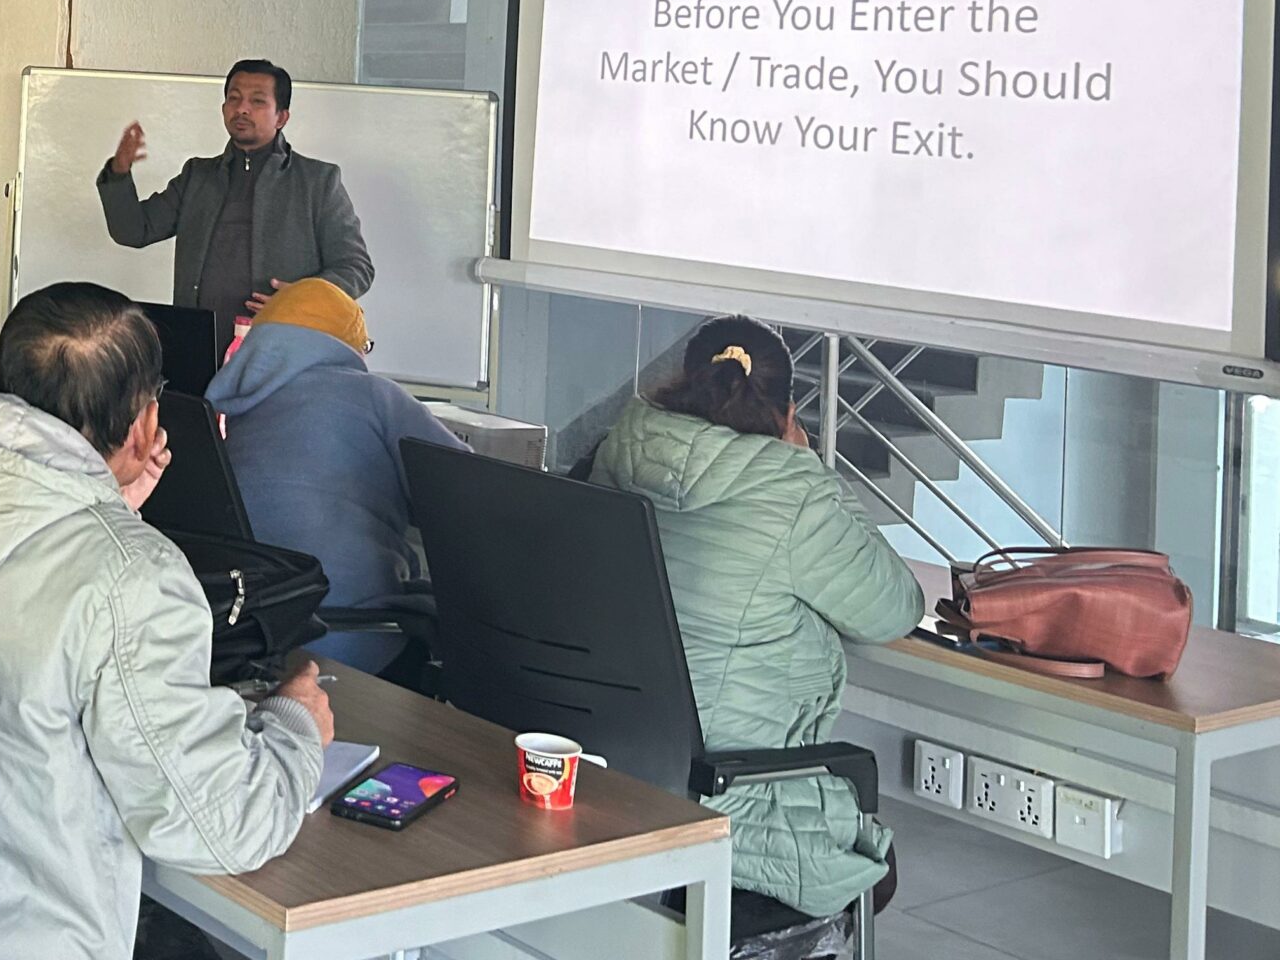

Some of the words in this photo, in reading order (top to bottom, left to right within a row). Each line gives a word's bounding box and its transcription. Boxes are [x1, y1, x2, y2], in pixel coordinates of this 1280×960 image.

[600, 50, 714, 86] Market
[721, 50, 741, 93] /
[749, 55, 860, 99] Trade,
[874, 59, 943, 96] You
[957, 59, 1113, 102] Should
[688, 108, 783, 146] Know
[794, 114, 878, 152] Your
[891, 120, 974, 160] Exit.
[1225, 366, 1261, 379] VEGA
